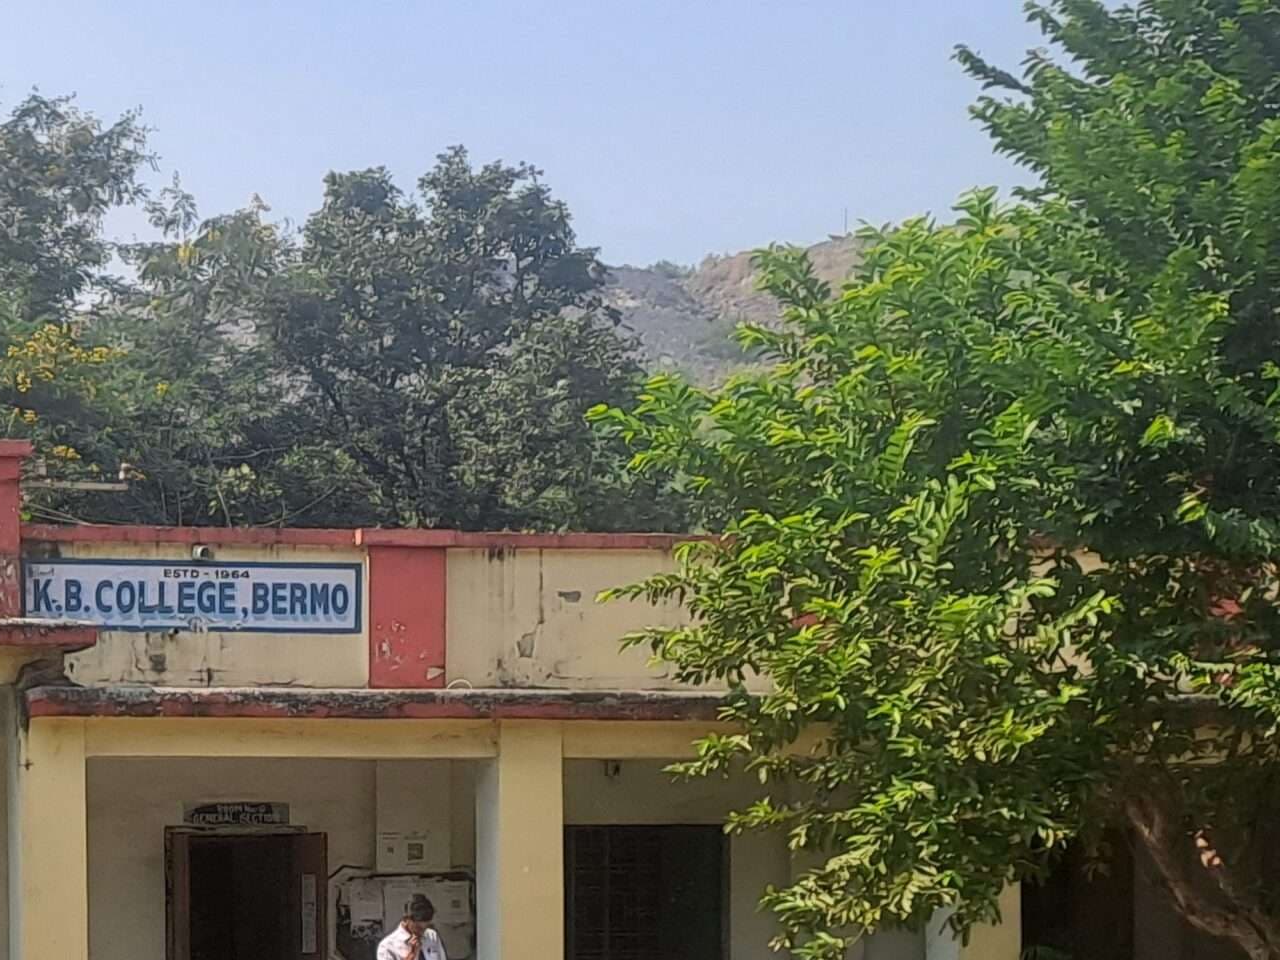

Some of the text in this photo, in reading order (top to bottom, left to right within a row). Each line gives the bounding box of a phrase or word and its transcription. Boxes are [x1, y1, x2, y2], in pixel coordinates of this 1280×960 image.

[163, 568, 200, 579] ESTD
[215, 569, 250, 579] 1964
[252, 582, 350, 615] BERMO
